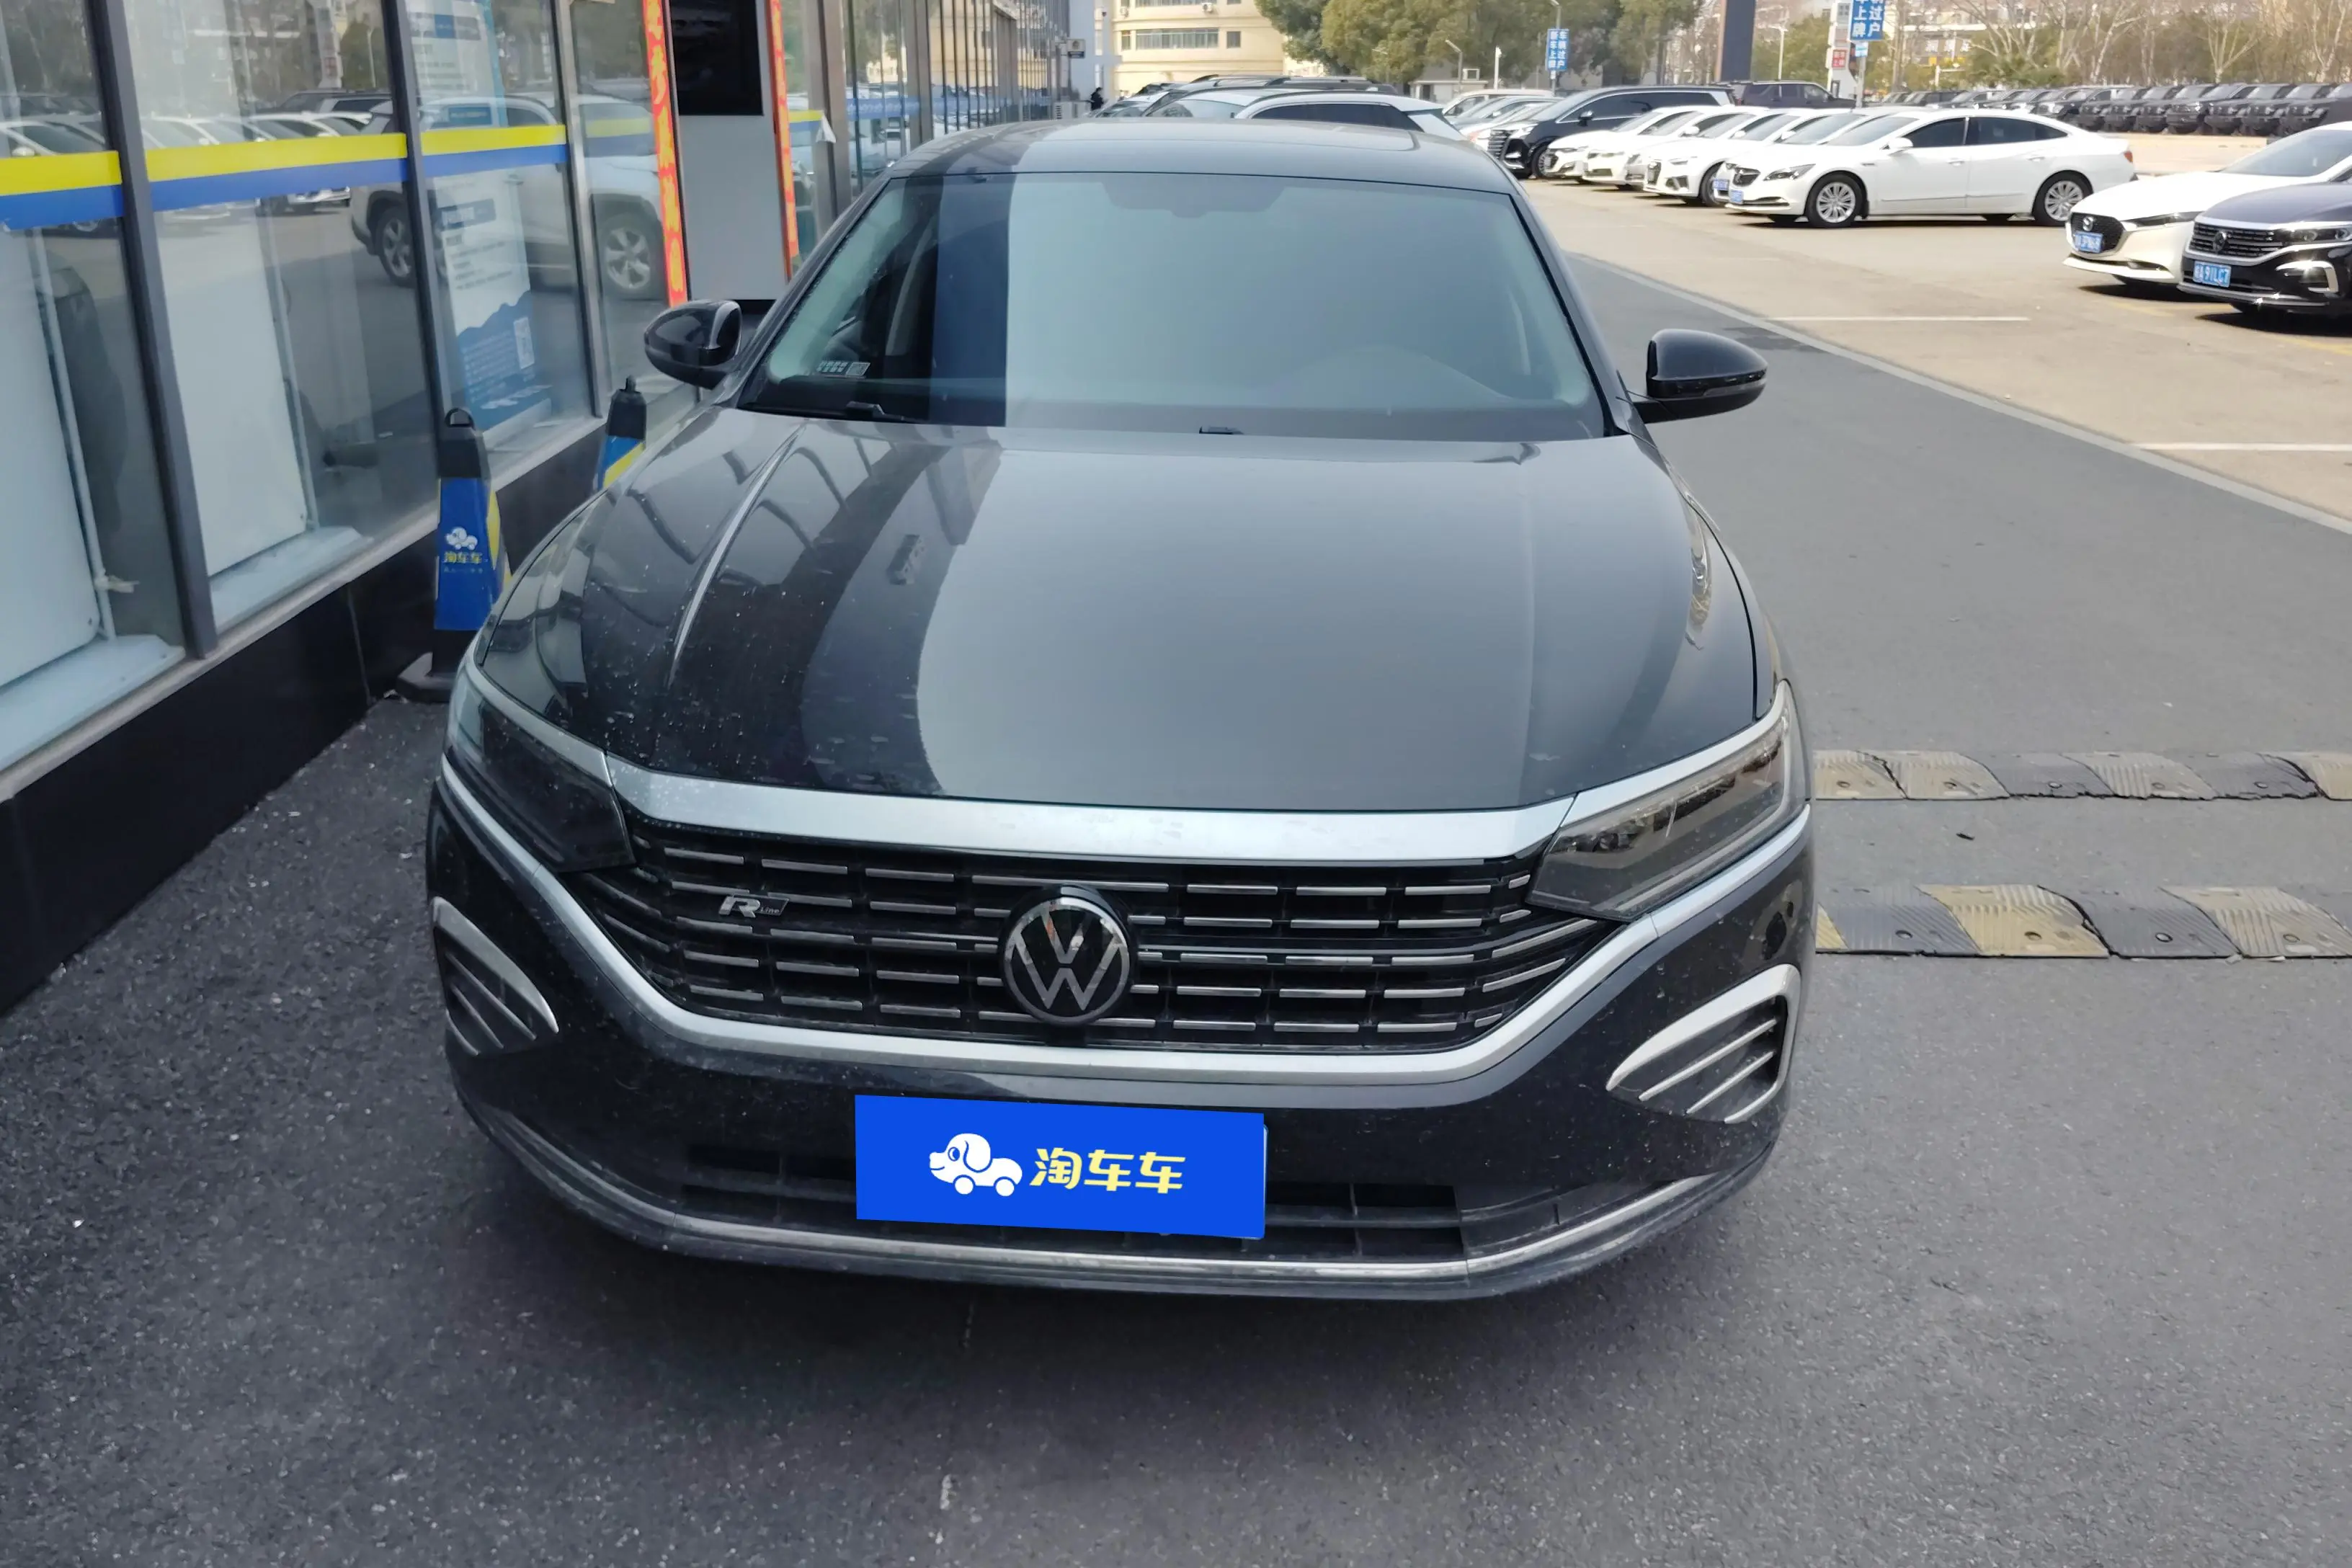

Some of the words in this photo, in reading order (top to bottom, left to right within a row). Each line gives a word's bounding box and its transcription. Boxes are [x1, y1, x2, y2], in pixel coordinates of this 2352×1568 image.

[1851, 0, 1867, 37] 上牌
[1867, 0, 1884, 37] 过户
[718, 896, 761, 918] R
